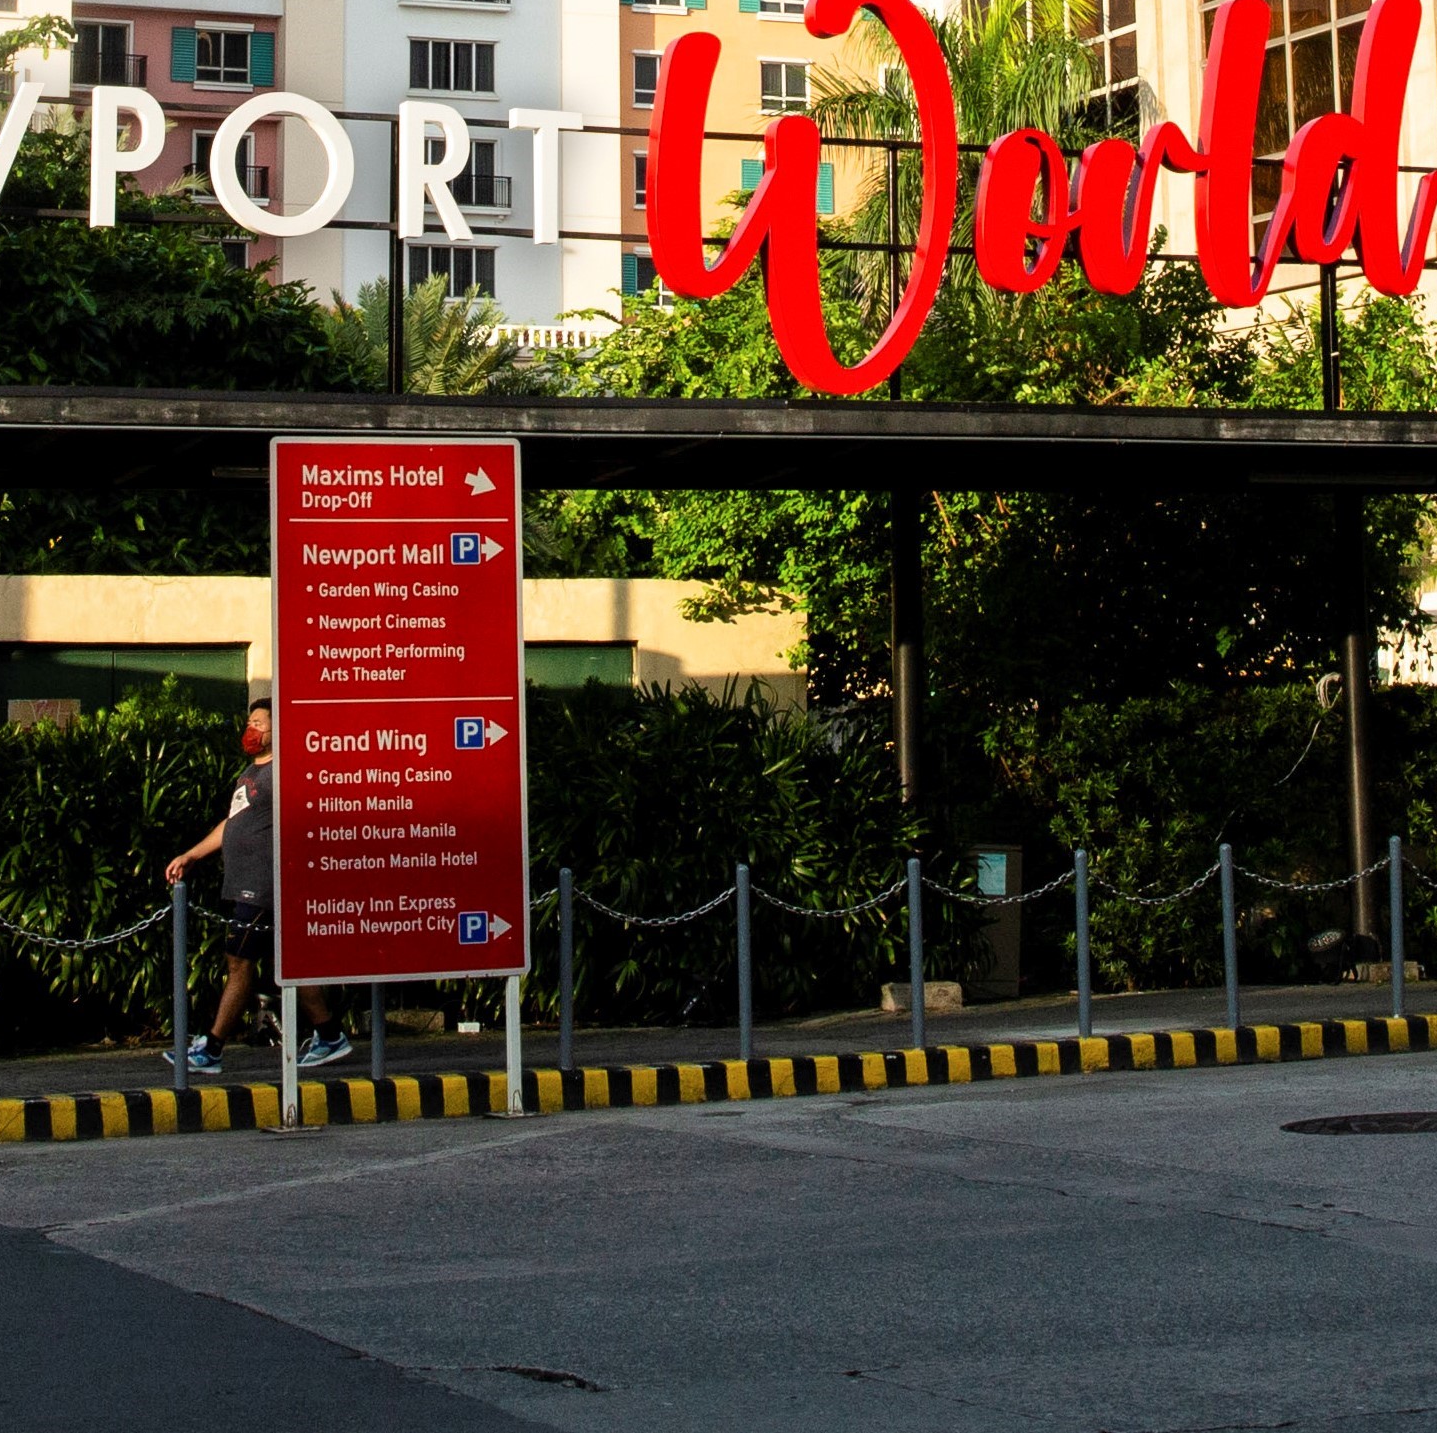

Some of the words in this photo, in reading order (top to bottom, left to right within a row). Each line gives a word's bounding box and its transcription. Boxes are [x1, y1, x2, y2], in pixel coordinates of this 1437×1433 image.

[302, 464, 383, 486] Maxims
[391, 466, 444, 486] Hotel
[302, 491, 372, 512] Drop-Off
[303, 544, 396, 570] Newport
[402, 544, 444, 565] Mall
[459, 537, 475, 559] P
[319, 583, 370, 598] Garden
[374, 582, 407, 601] Wing
[412, 582, 459, 597] Casino
[319, 615, 381, 632] Newport
[386, 614, 446, 629] Cinemas
[319, 644, 381, 662] Newport
[386, 643, 465, 662] Performing
[320, 667, 349, 682] Arts
[353, 666, 406, 682] Theater
[305, 730, 370, 753] Grand
[377, 729, 427, 757] Wing
[463, 721, 479, 744] P
[318, 769, 362, 785] Grand
[366, 768, 400, 787] Wing
[405, 767, 453, 783] Casino
[319, 797, 362, 812] Hilton
[366, 796, 413, 811] Manila
[319, 826, 357, 841] Hotel
[361, 825, 405, 840] Okura
[410, 823, 456, 838] Manila
[320, 854, 385, 871] Sheraton
[390, 853, 437, 868] Manila
[441, 851, 478, 866] Hotel
[306, 898, 365, 916] Holiday
[369, 897, 394, 912] Inn
[399, 896, 456, 913] Express
[307, 919, 355, 936] Manila
[360, 918, 423, 935] Newport
[426, 916, 456, 933] City
[467, 916, 482, 938] P
